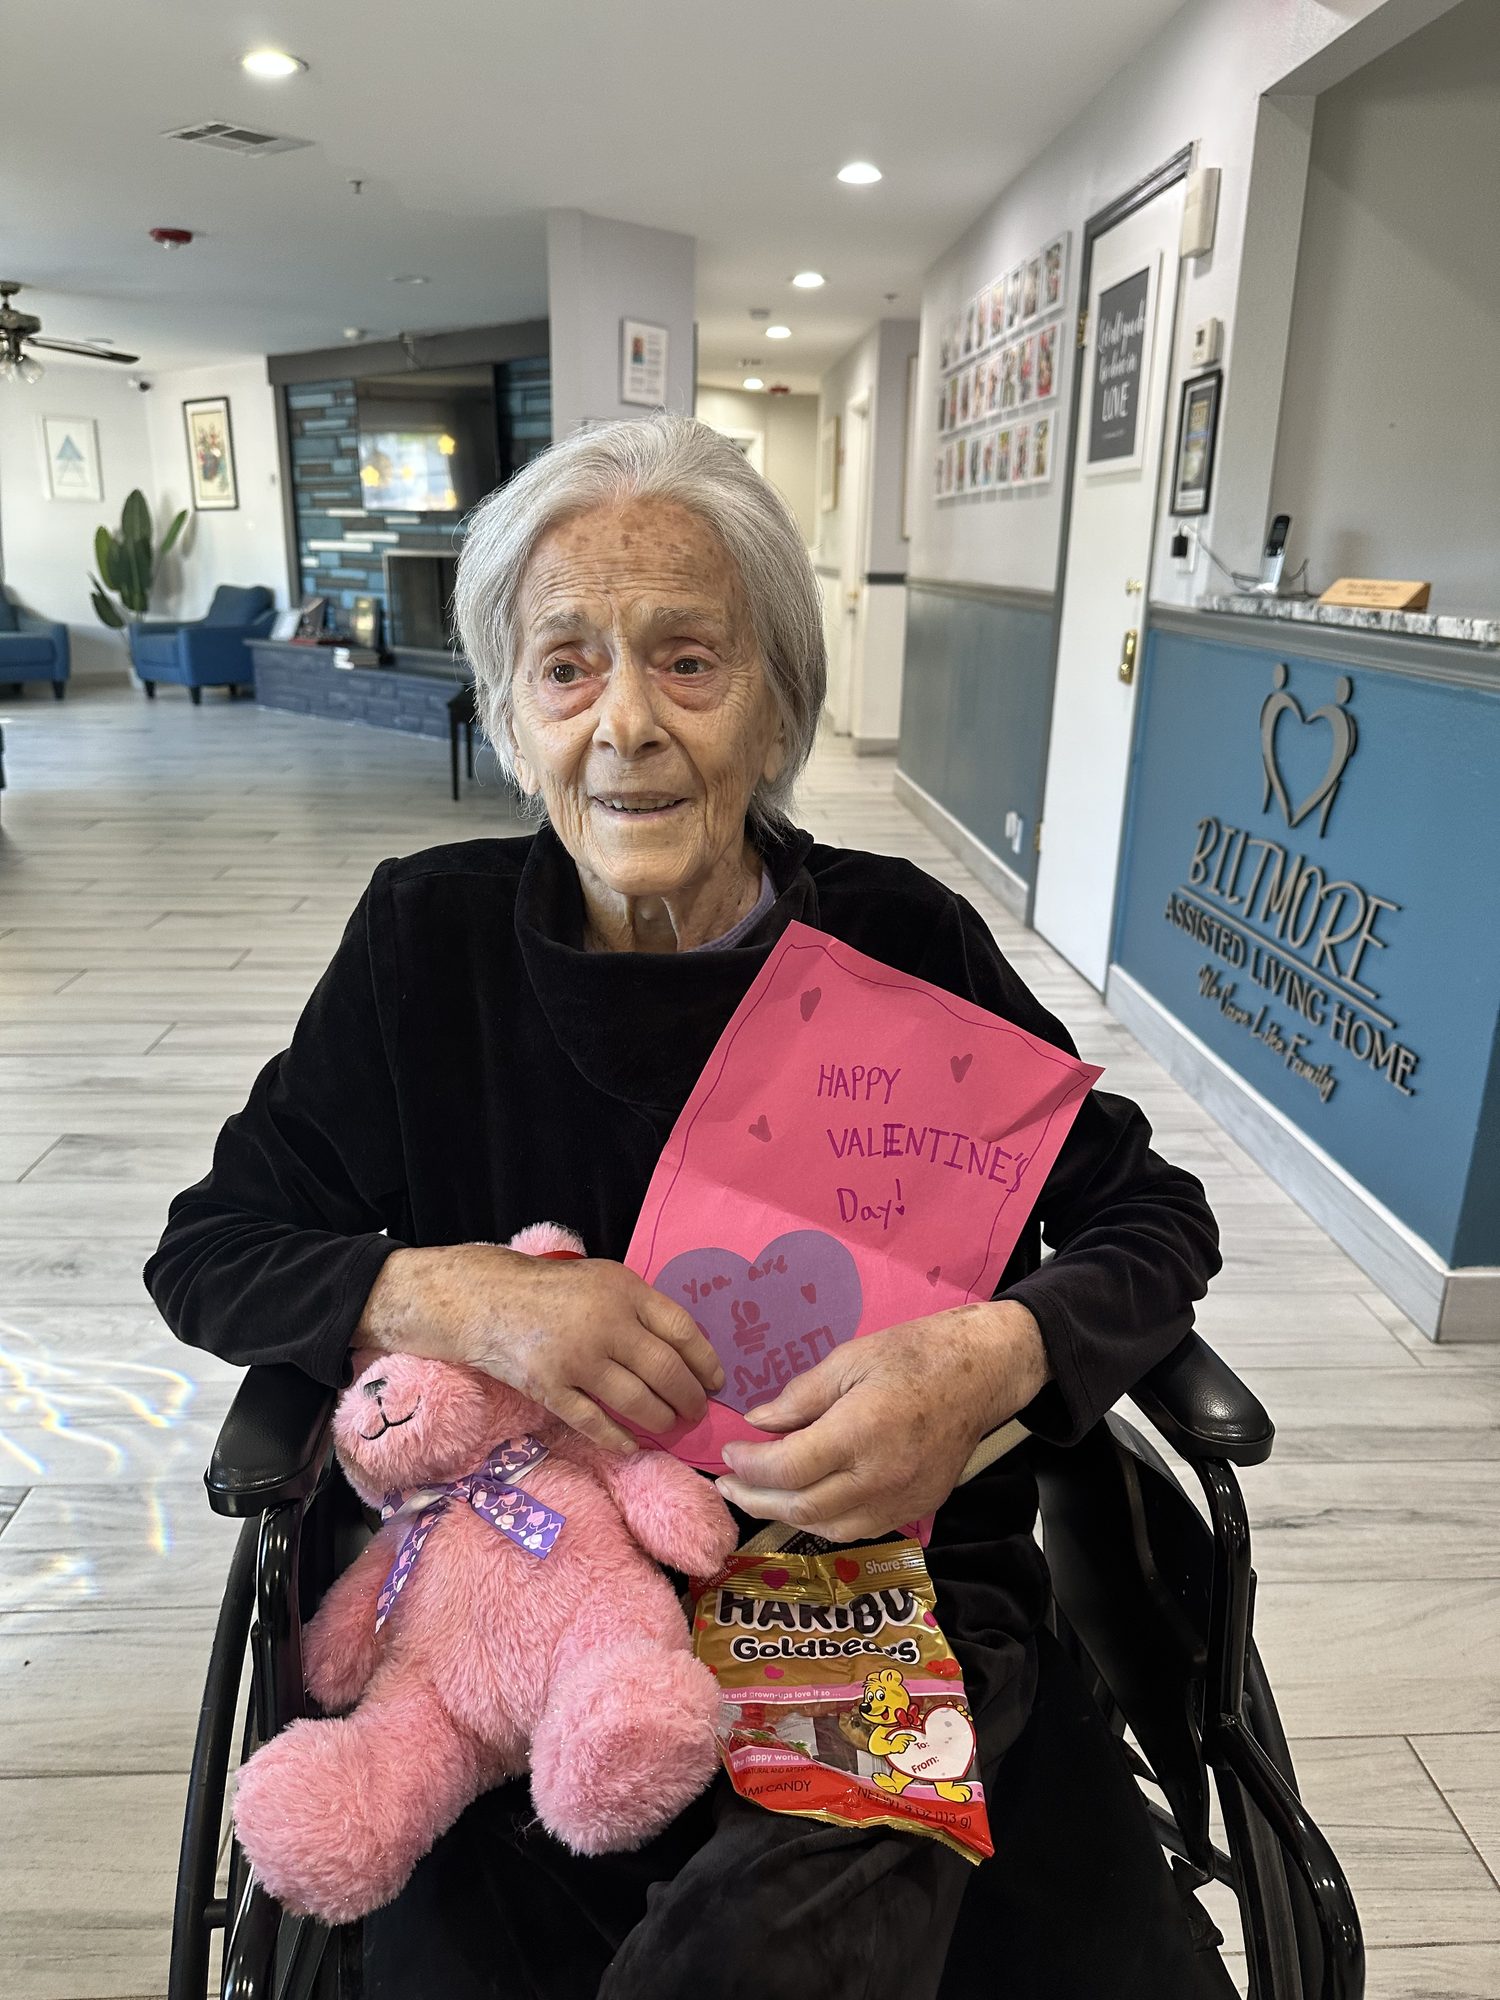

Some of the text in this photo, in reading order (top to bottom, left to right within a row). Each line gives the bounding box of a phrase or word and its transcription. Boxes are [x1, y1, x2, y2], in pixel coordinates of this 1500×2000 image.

[1188, 816, 1403, 1000] BILTMORE
[1164, 893, 1420, 1097] ASSISTED LIVING HOME
[817, 1064, 901, 1104] HAPPY
[827, 1122, 1029, 1193] VALENTINE'S
[836, 1178, 905, 1230] Day!
[865, 1559, 901, 1575] Share
[731, 1691, 747, 1699] and
[794, 1690, 811, 1698] love
[813, 1689, 819, 1697] it
[914, 1741, 930, 1750] To:
[771, 1765, 784, 1774] AND
[911, 1755, 940, 1774] From:
[766, 1780, 812, 1793] CANDY
[960, 1815, 972, 1830] g)
